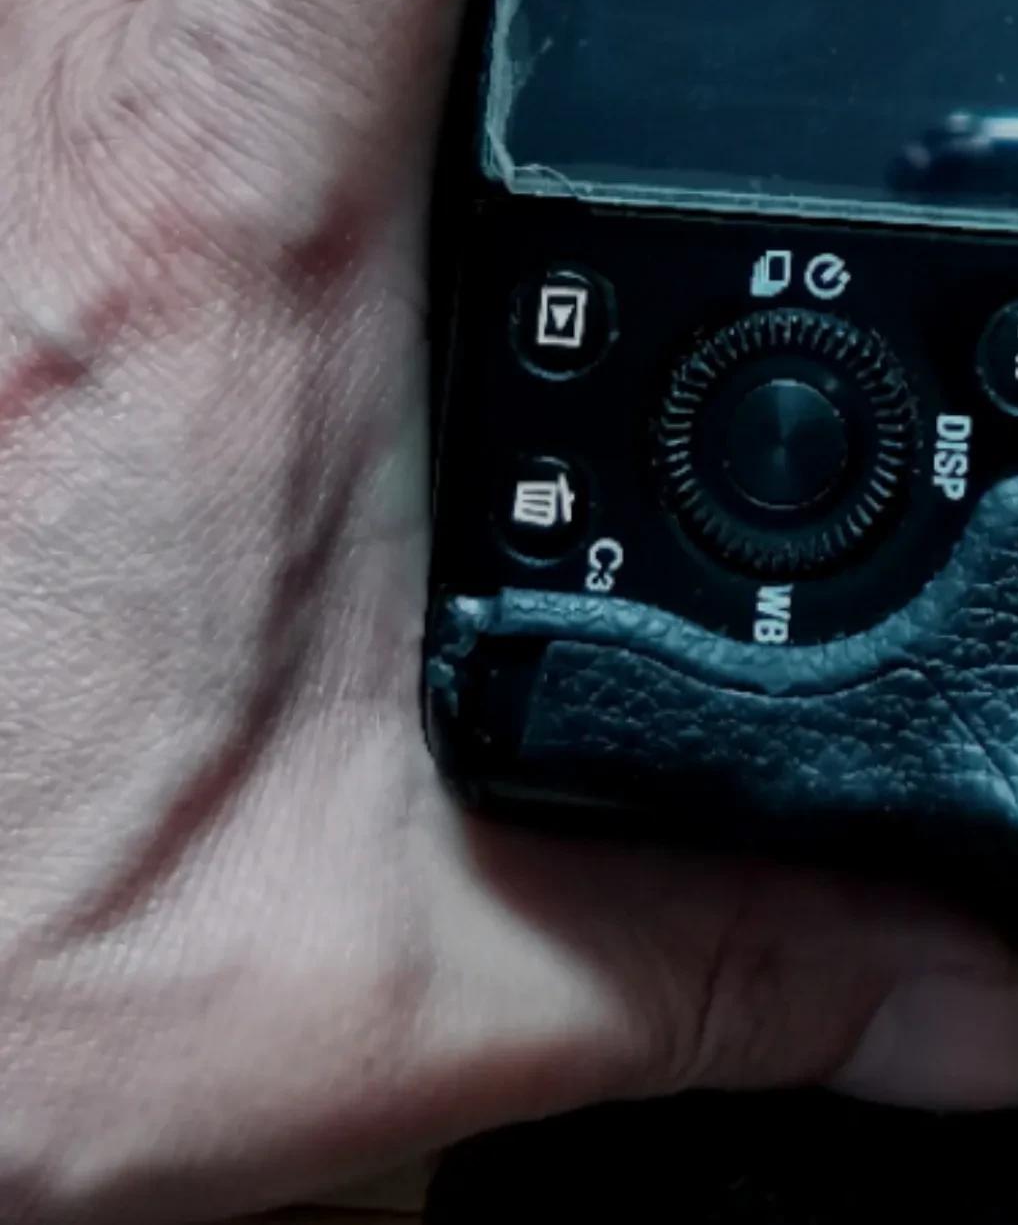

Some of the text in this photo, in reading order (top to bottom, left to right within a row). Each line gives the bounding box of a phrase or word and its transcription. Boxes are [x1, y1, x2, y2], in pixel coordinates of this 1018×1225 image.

[933, 413, 972, 501] DISP
[584, 538, 623, 592] C3
[753, 583, 792, 645] WB
